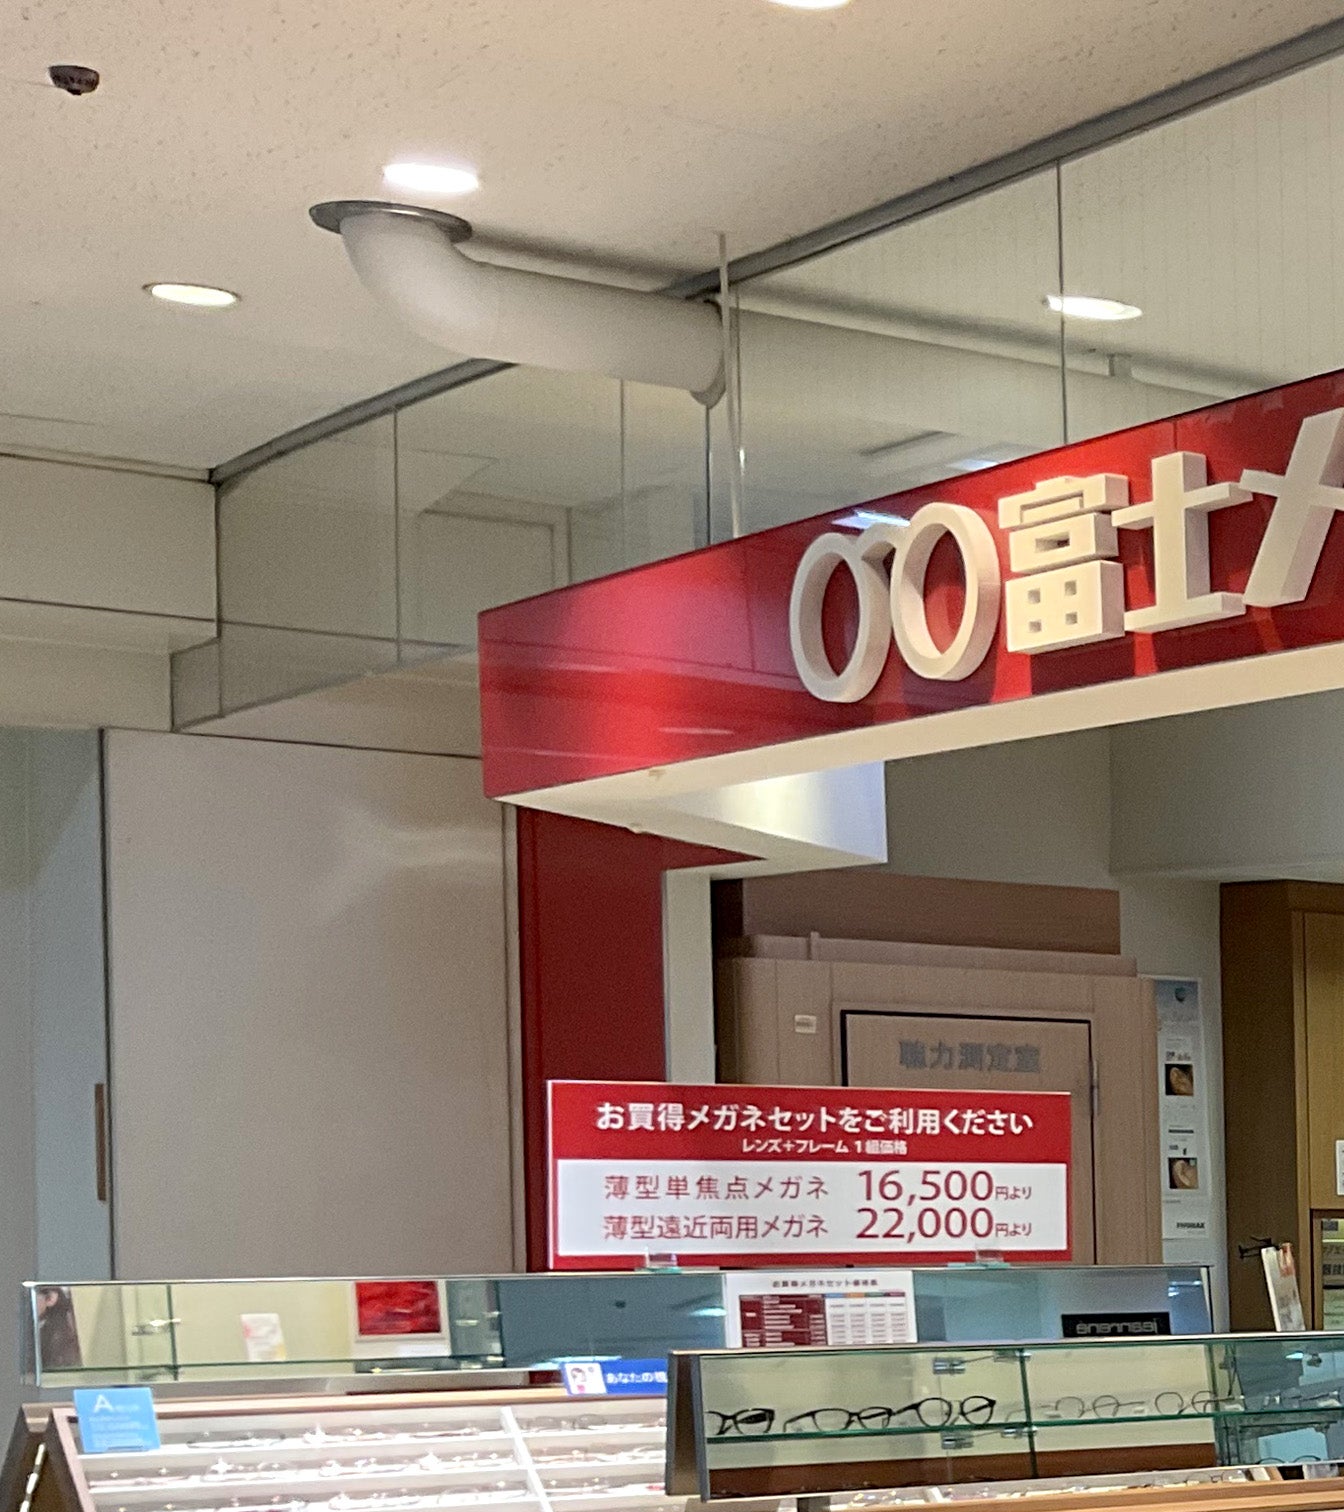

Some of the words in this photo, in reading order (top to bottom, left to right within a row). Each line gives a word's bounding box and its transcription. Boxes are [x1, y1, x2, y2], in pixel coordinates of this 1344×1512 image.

[596, 1101, 1034, 1136] お買得メガネセットをご利用ください
[604, 1174, 830, 1201] 薄型単焦点メガネ
[603, 1213, 830, 1241] 薄型遠近両用メガネ
